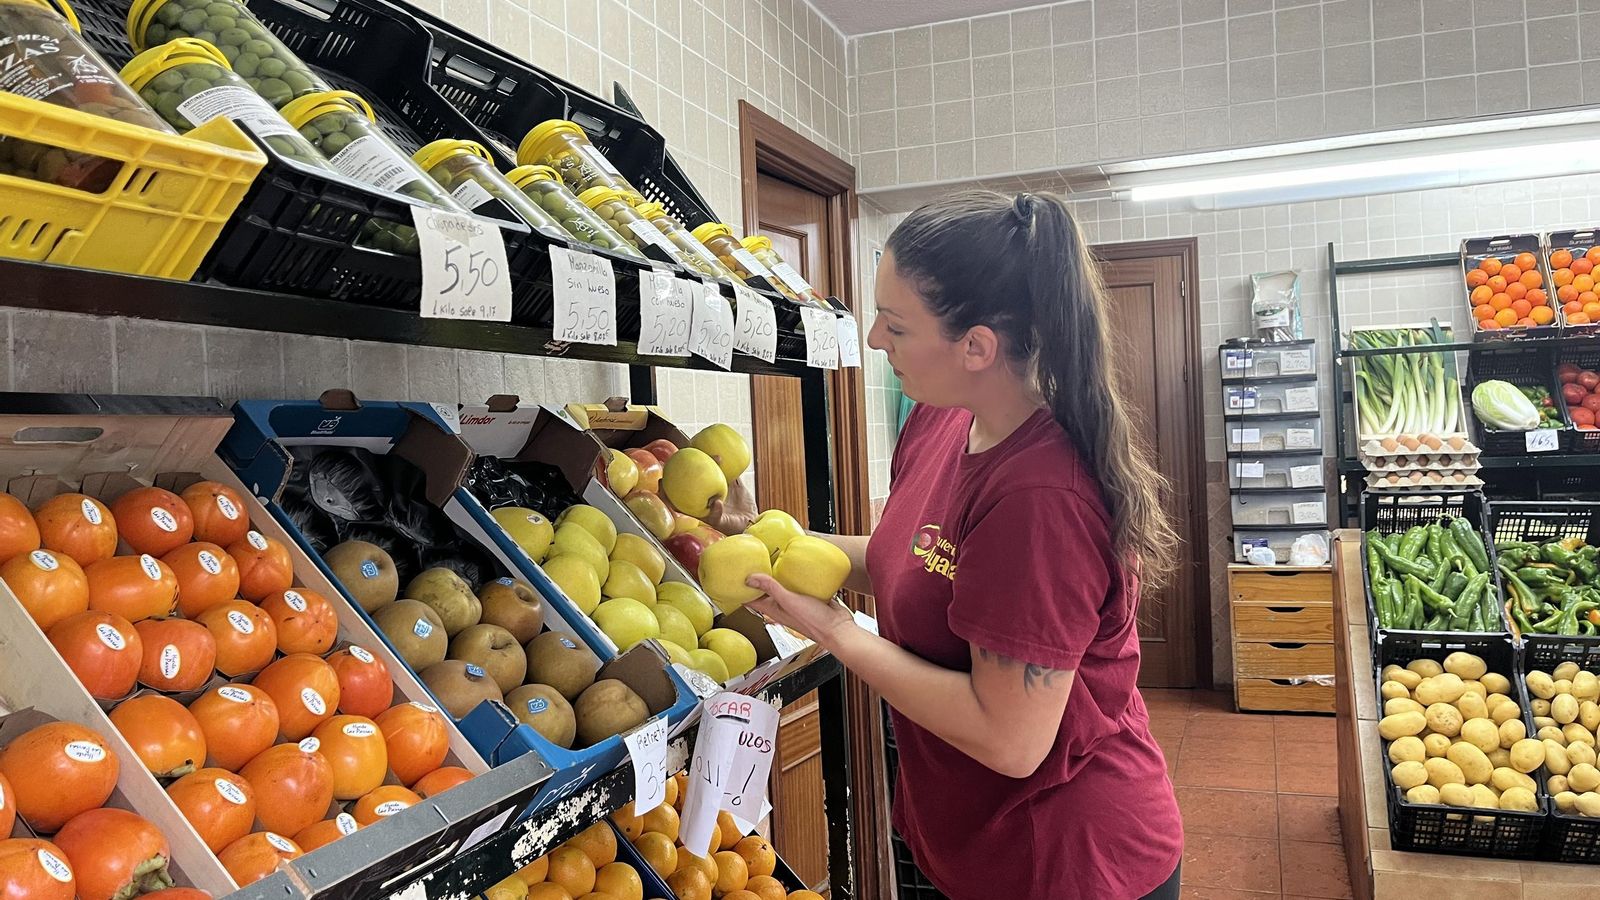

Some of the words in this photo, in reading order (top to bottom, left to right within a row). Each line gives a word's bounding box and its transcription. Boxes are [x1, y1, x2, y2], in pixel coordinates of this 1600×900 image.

[17, 34, 60, 44] MESA
[440, 245, 498, 296] 5,50
[566, 302, 610, 330] 5,50
[650, 314, 687, 345] 5,20
[744, 310, 773, 339] 5,20
[698, 320, 731, 349] 5,20
[812, 328, 836, 354] 5,20
[460, 414, 496, 425] Limdor
